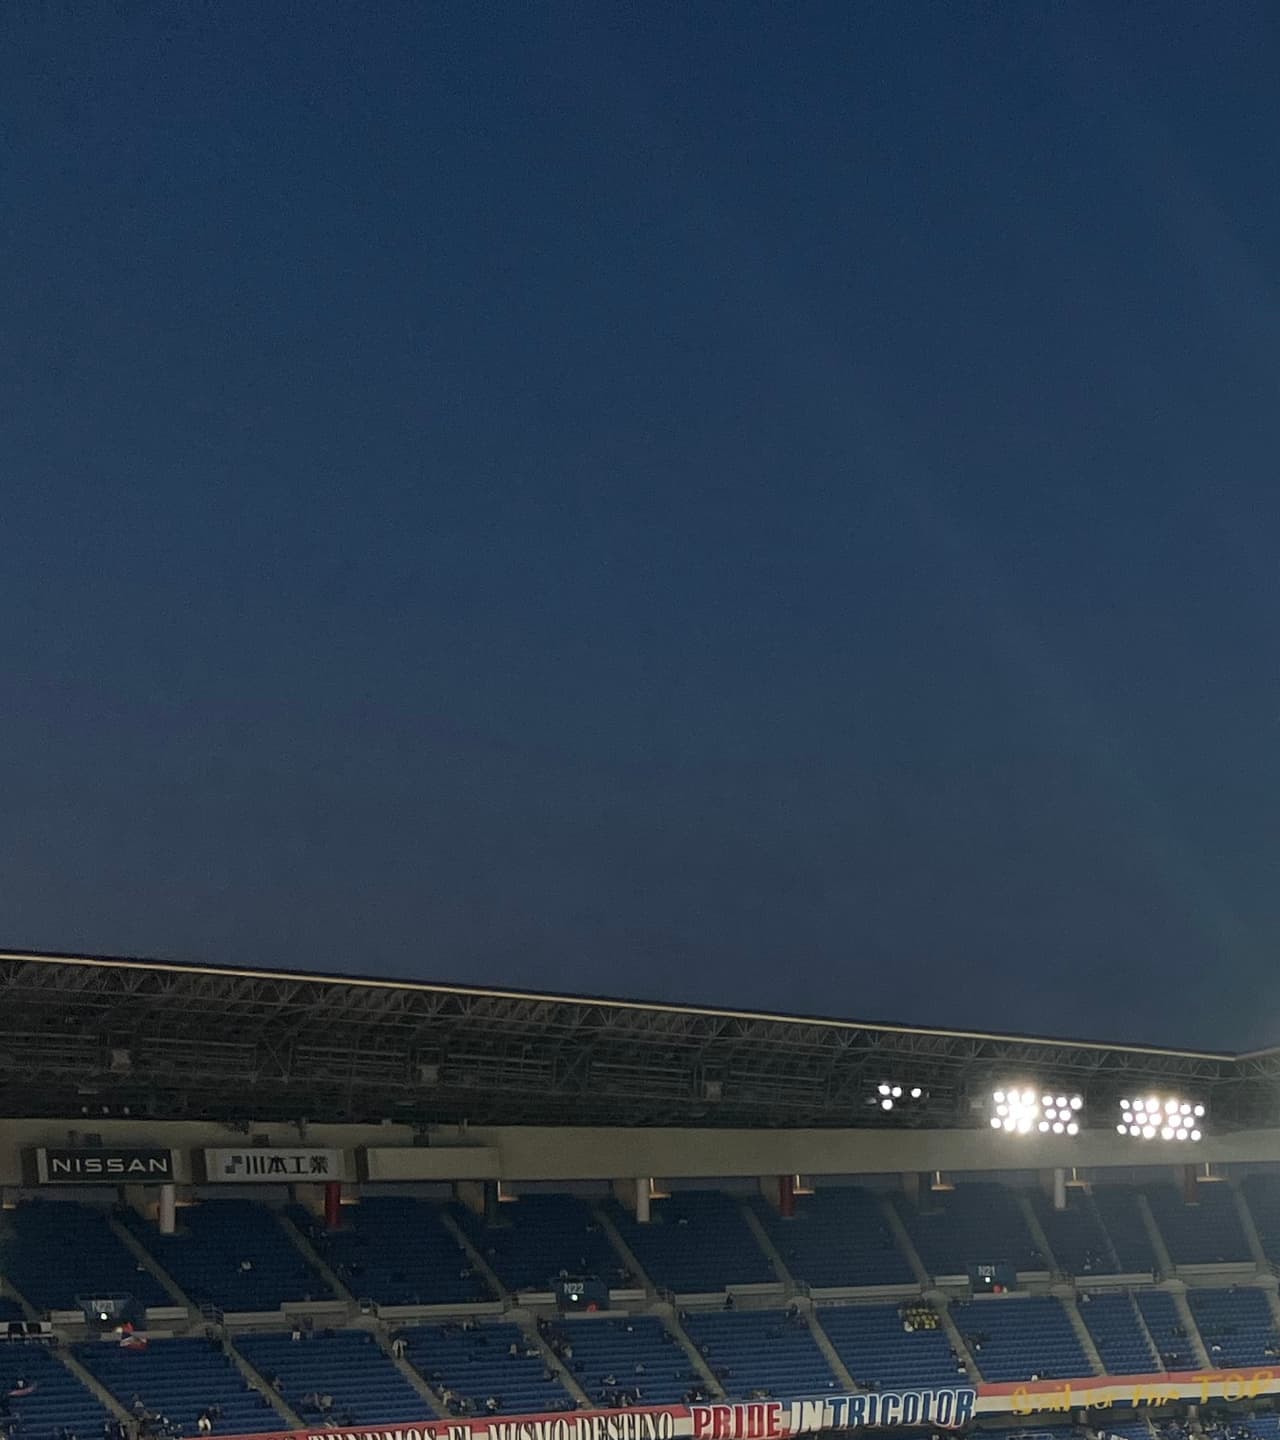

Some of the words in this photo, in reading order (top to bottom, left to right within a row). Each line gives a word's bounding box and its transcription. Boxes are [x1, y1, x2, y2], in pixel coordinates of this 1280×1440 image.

[52, 1157, 168, 1174] NISSAN
[246, 1154, 329, 1175] 川本工業
[563, 1283, 584, 1294] N22
[789, 1400, 826, 1433] IN
[825, 1389, 977, 1430] TRICOLOR
